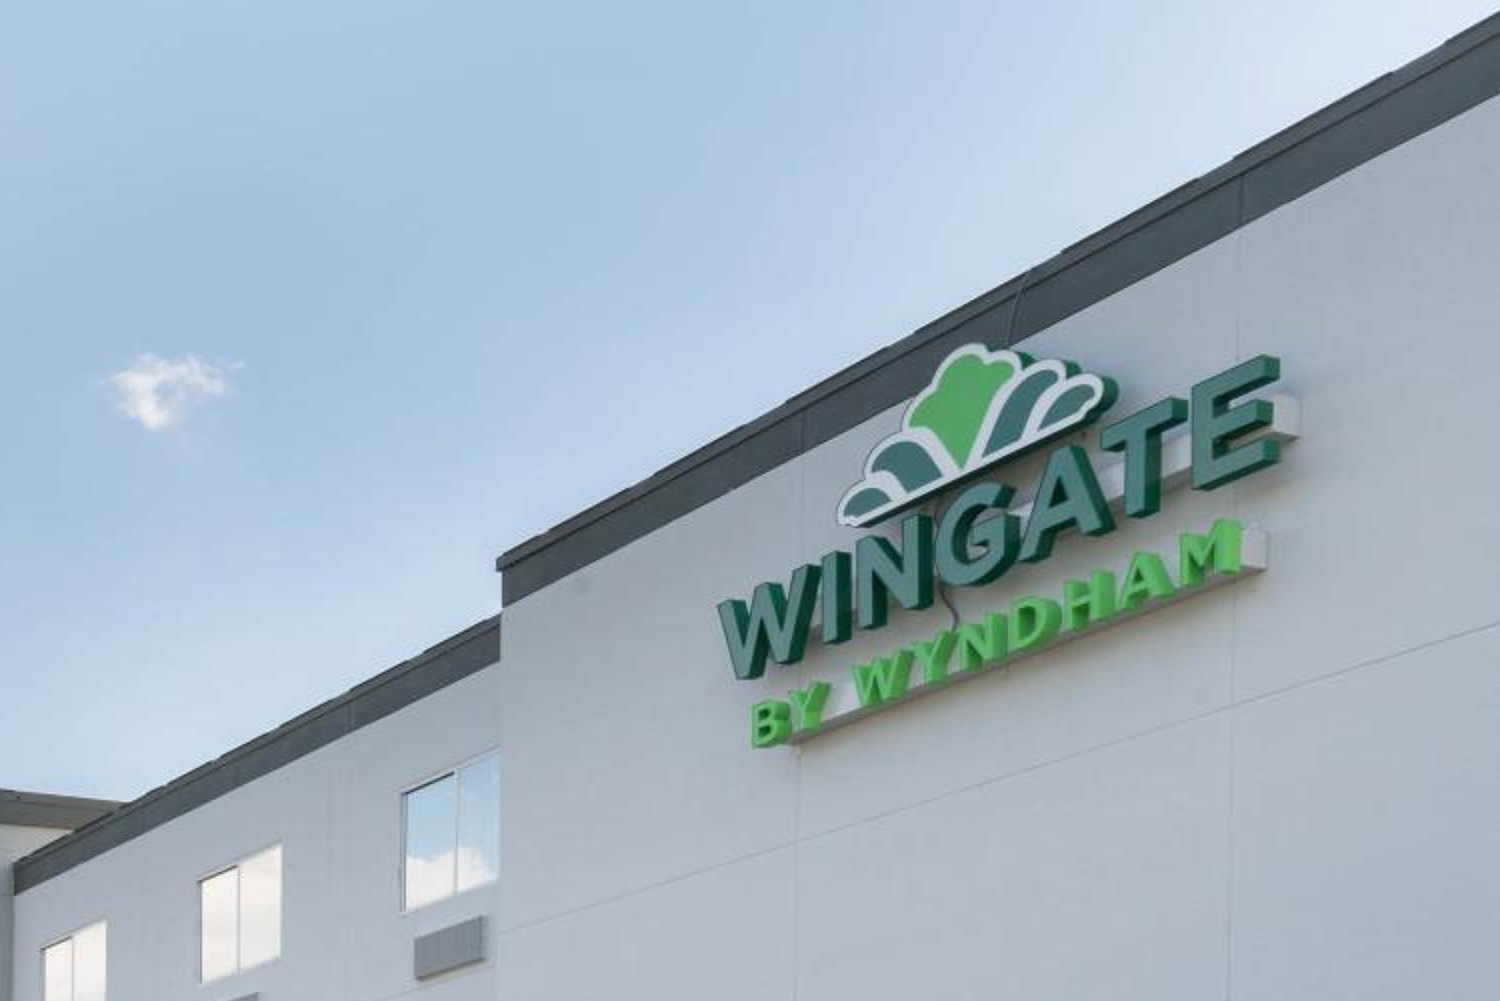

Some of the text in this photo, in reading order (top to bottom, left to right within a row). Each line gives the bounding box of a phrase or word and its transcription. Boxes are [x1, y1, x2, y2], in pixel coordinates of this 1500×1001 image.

[717, 354, 1282, 680] WINGATE
[751, 517, 1243, 748] BY WYNDHAM
